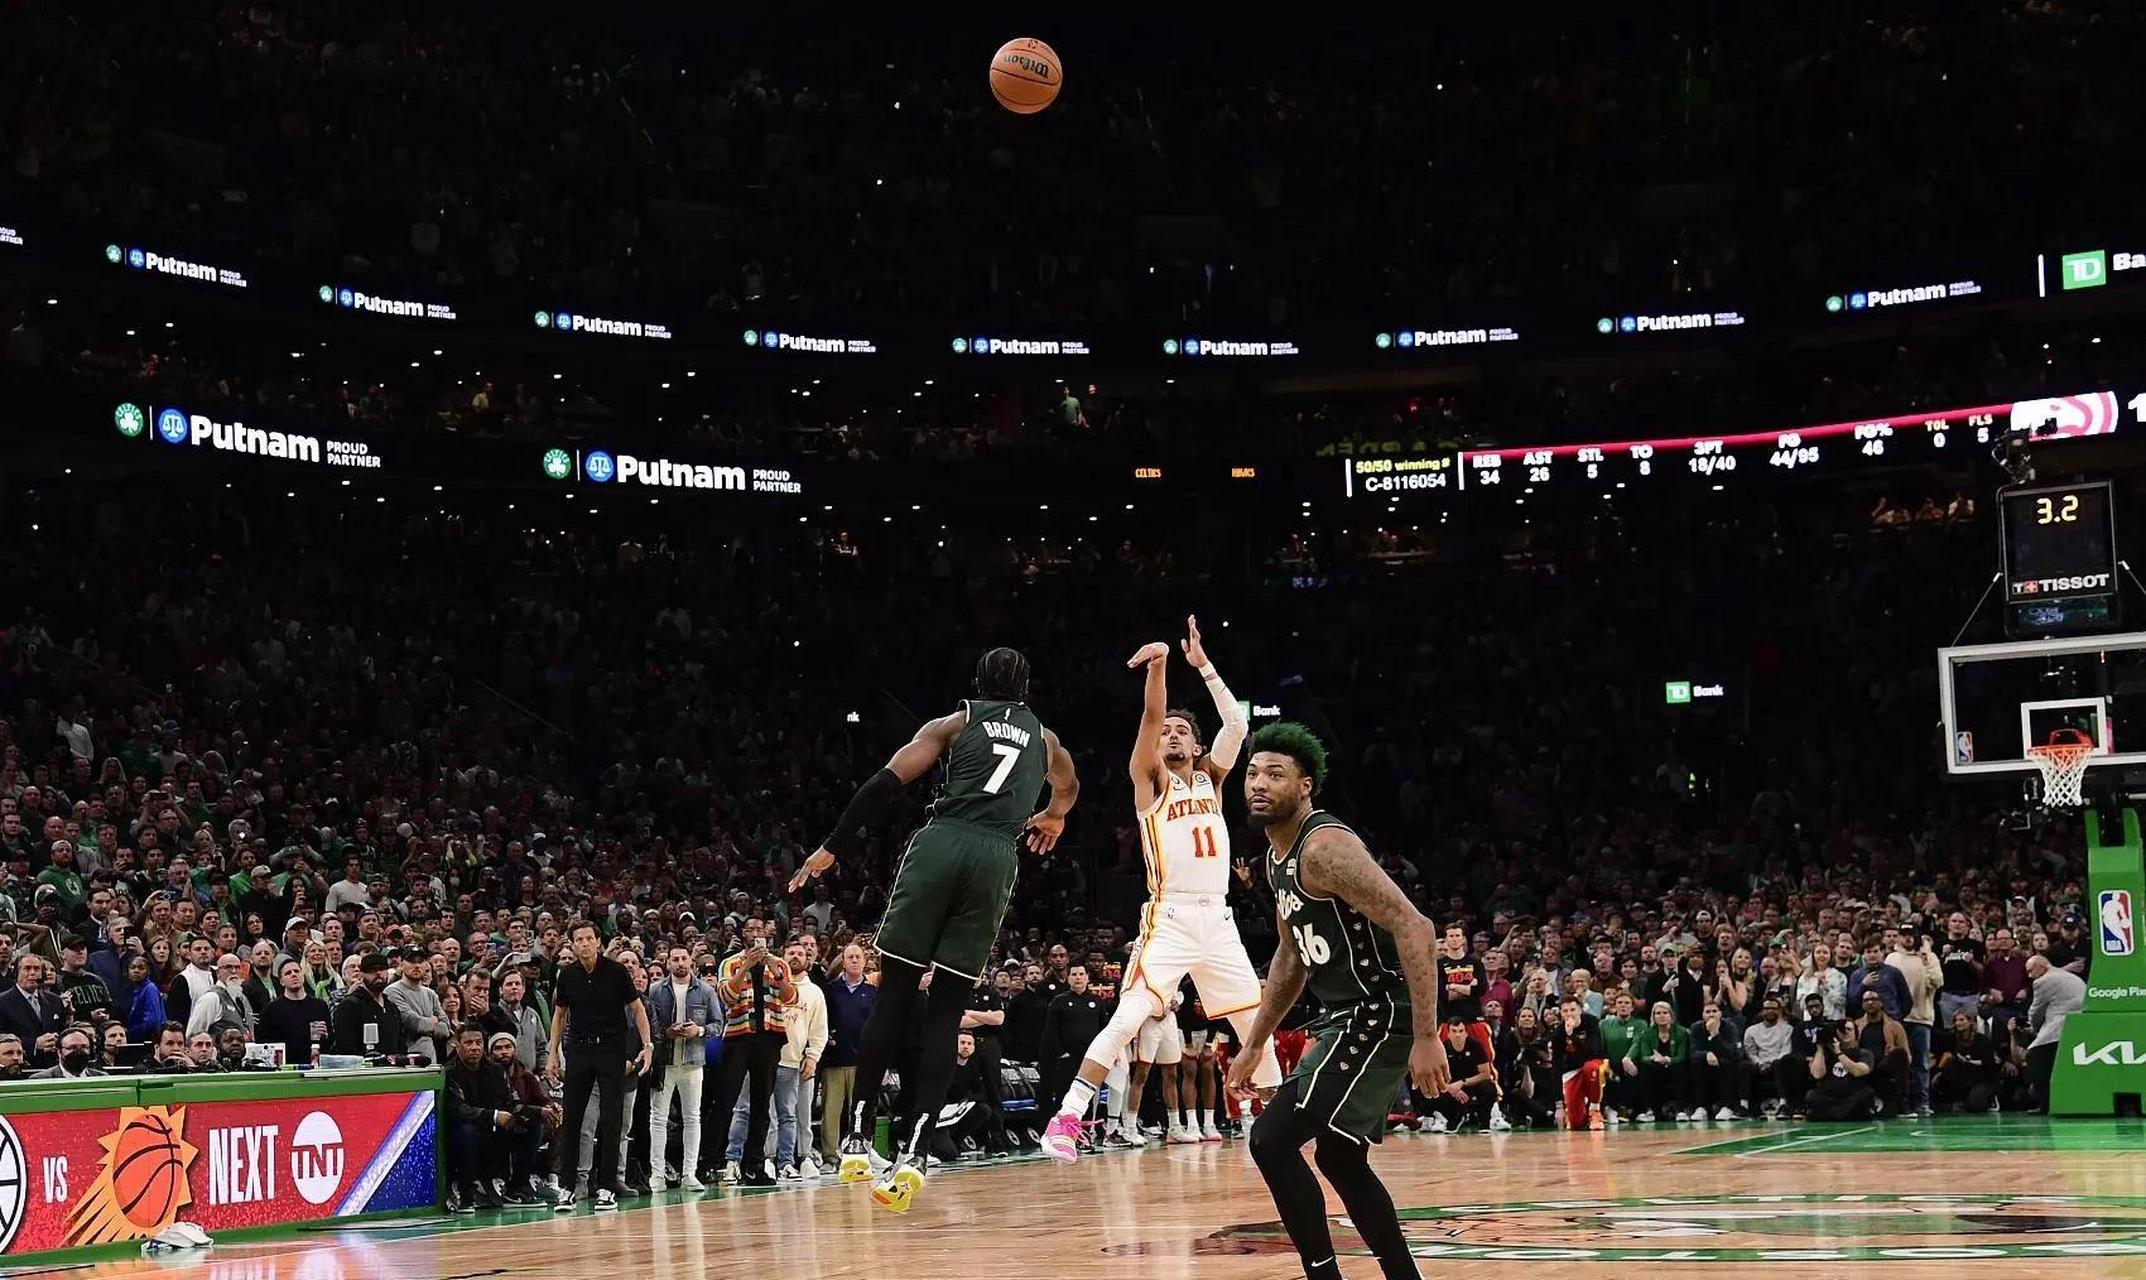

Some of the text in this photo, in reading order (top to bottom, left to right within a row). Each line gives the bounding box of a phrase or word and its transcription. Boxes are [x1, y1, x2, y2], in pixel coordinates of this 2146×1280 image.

[1003, 55, 1049, 79] Wilson
[146, 252, 217, 282] Putnam
[2066, 252, 2146, 282] TD Ba
[1867, 284, 1947, 307] Putnam
[354, 292, 424, 317] Putnam
[572, 314, 642, 337] Putnam
[1637, 313, 1712, 332] Putnam
[779, 333, 846, 353] Putnam
[1414, 329, 1487, 347] Putnam
[990, 339, 1060, 355] Putnam
[1200, 340, 1268, 355] Putnam
[1925, 419, 1949, 432] TOL
[1968, 413, 1993, 427] FLS
[190, 414, 320, 463] Putnam
[1933, 432, 1946, 448] 0
[1977, 427, 1989, 443] 5
[326, 440, 368, 455] PROUD
[1577, 448, 1604, 463] STL
[1630, 444, 1653, 459] TO
[1694, 440, 1724, 455] 3PT
[1861, 440, 1884, 456] 46
[327, 453, 381, 468] PARTNER
[1355, 459, 1392, 473] 50/50
[1395, 457, 1440, 472] winning
[1523, 451, 1553, 465] AST
[1688, 455, 1736, 475] 18/40
[1769, 447, 1820, 469] 44/95
[616, 455, 746, 490] Putnam
[753, 469, 791, 481] PROUD
[1529, 467, 1550, 482] 26
[1587, 464, 1598, 479] 5
[1639, 460, 1651, 475] 8
[1365, 473, 1447, 492] C-8116054
[1480, 470, 1500, 485] 34
[753, 480, 801, 493] PARTNER
[2036, 495, 2079, 524] 3.2
[2039, 573, 2110, 592] TISSOT
[1693, 684, 1724, 697] Bank
[847, 711, 860, 722] nk
[1253, 705, 1281, 716] Bank
[982, 721, 1031, 748] BROWN
[982, 743, 1021, 794] 7
[1192, 826, 1217, 858] 11
[1292, 922, 1331, 967] 36
[71, 984, 106, 1004] ELTIC
[2089, 986, 2128, 1000] Google
[209, 1124, 279, 1206] NEXT
[43, 1157, 68, 1204] VS
